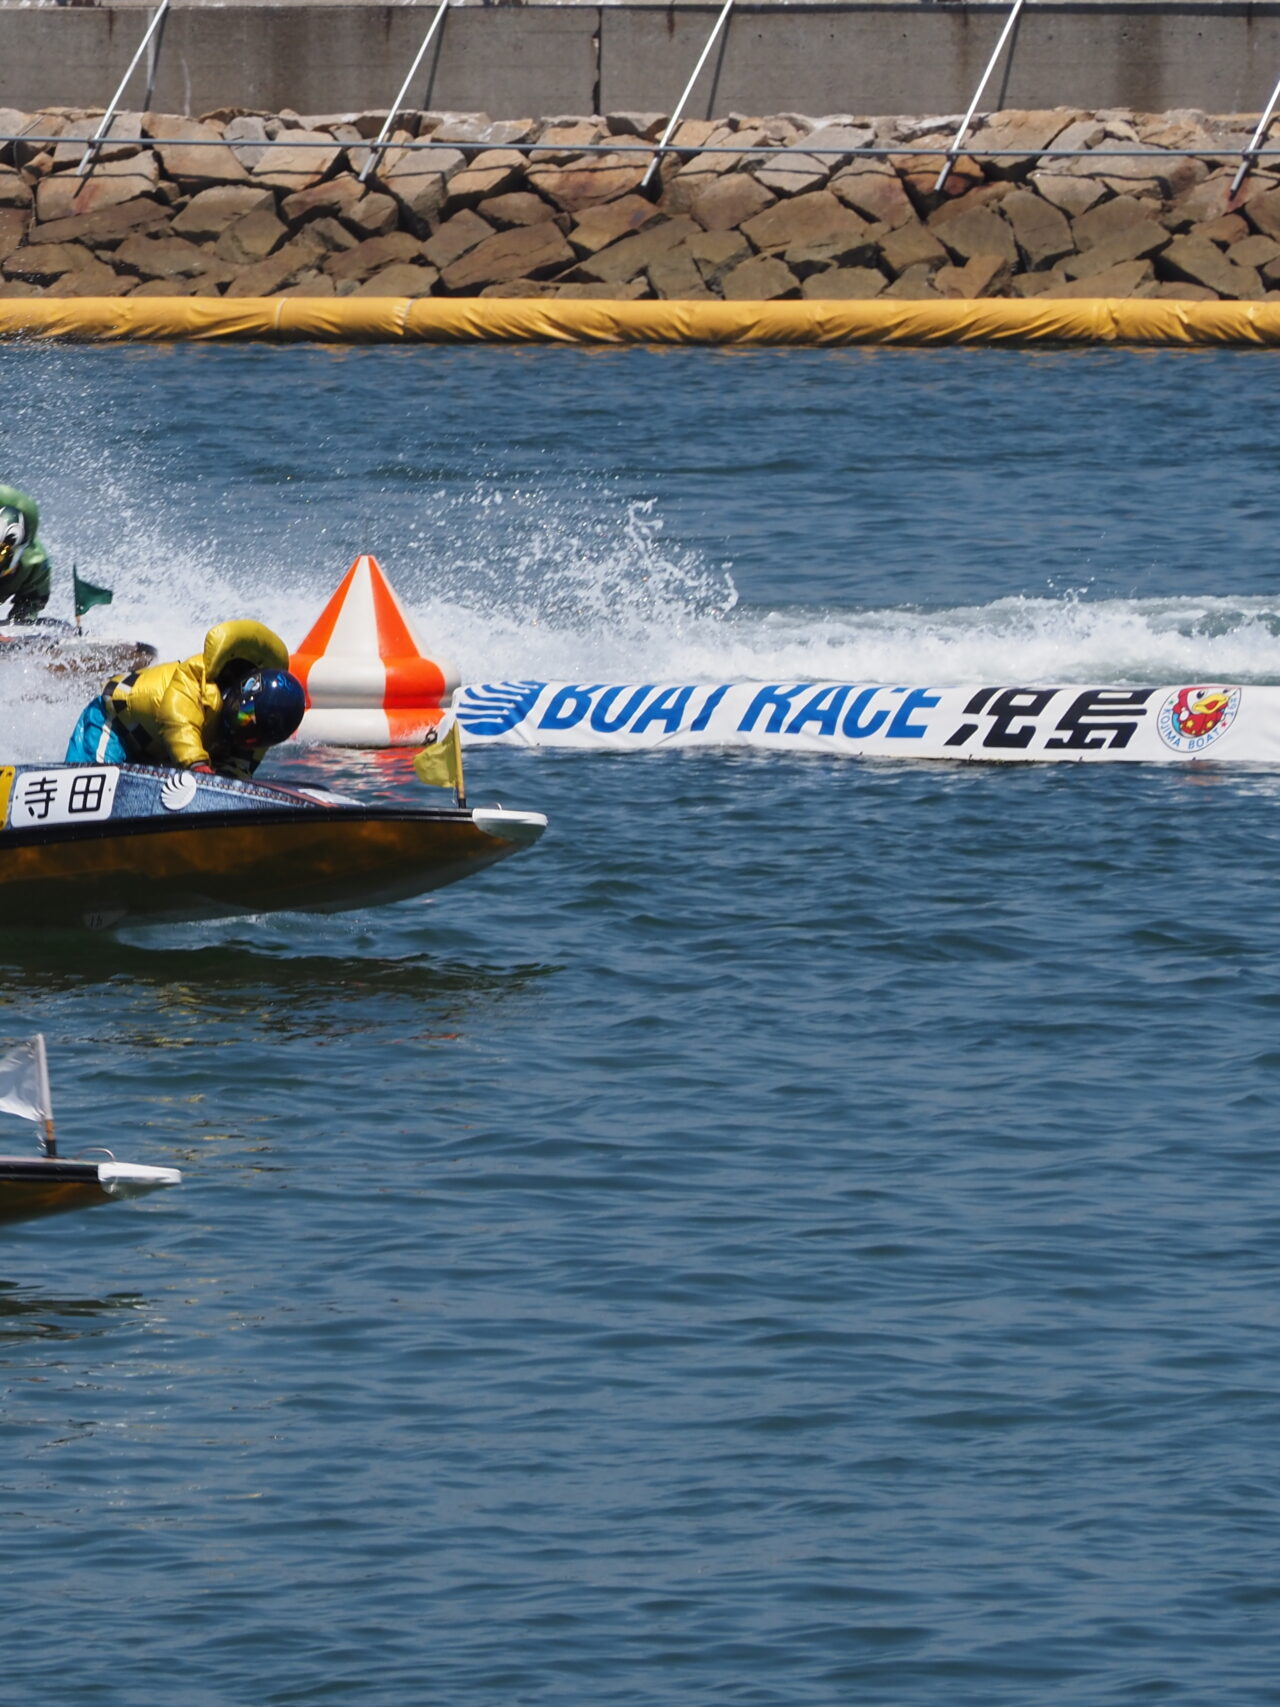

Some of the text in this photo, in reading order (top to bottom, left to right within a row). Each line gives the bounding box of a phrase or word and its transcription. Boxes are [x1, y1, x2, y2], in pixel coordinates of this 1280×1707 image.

[736, 683, 942, 738] RACE
[1160, 708, 1221, 750] KOJIMA BOAT
[24, 773, 108, 820] 寺田
